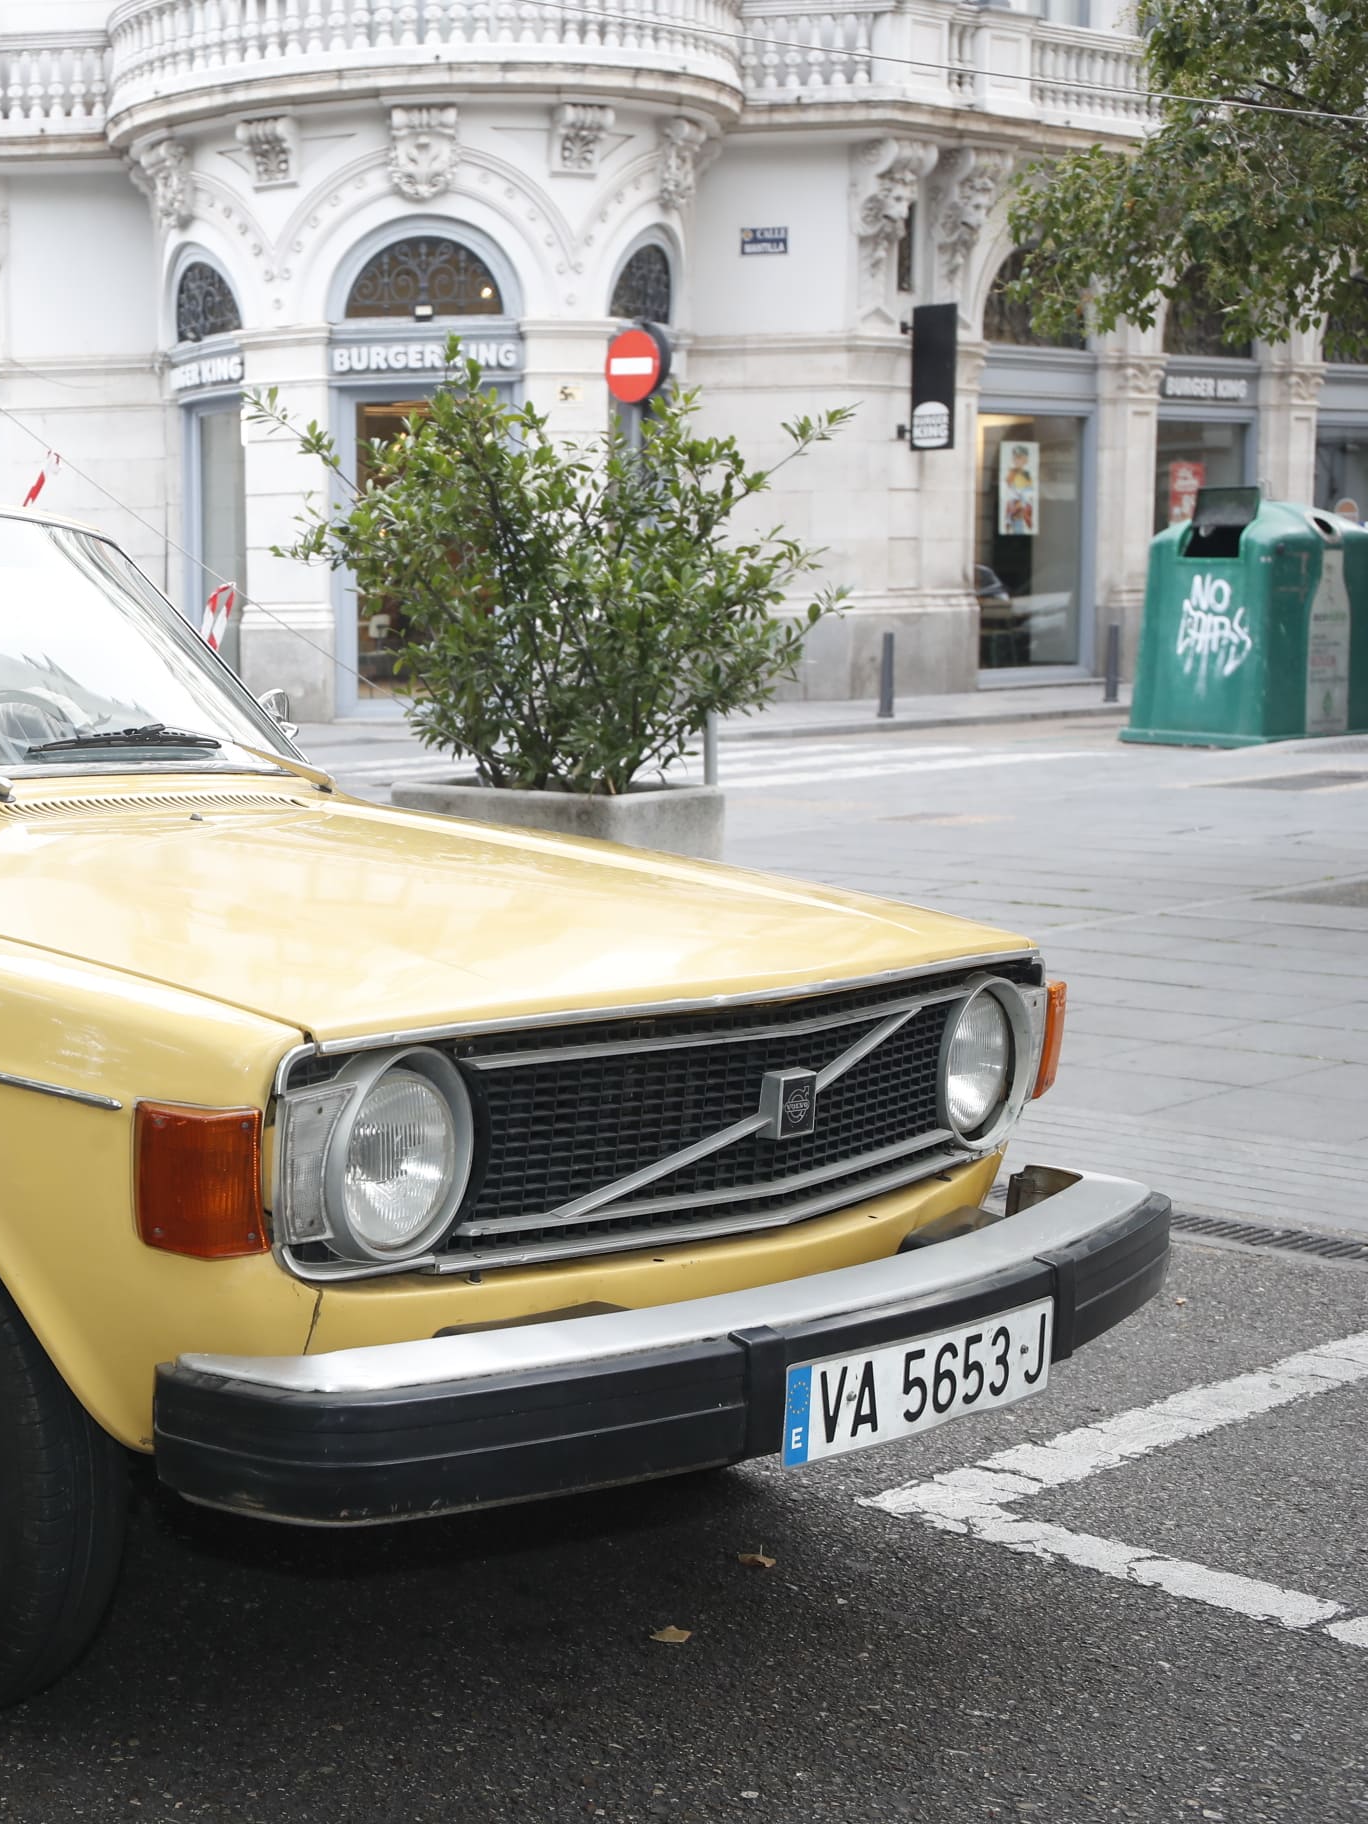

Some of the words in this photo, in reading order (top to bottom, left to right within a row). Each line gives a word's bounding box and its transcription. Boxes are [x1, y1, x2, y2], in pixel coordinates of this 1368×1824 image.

[755, 229, 786, 239] CALLE
[201, 355, 243, 383] KING
[333, 346, 444, 372] BURGER
[1165, 376, 1215, 397] BURGER
[1216, 379, 1248, 398] KING
[1190, 573, 1233, 614] NO
[786, 1102, 810, 1111] VOLVO
[820, 1361, 878, 1443] VA
[903, 1326, 1011, 1422] 5653
[1024, 1313, 1047, 1384] J
[791, 1427, 803, 1450] E
